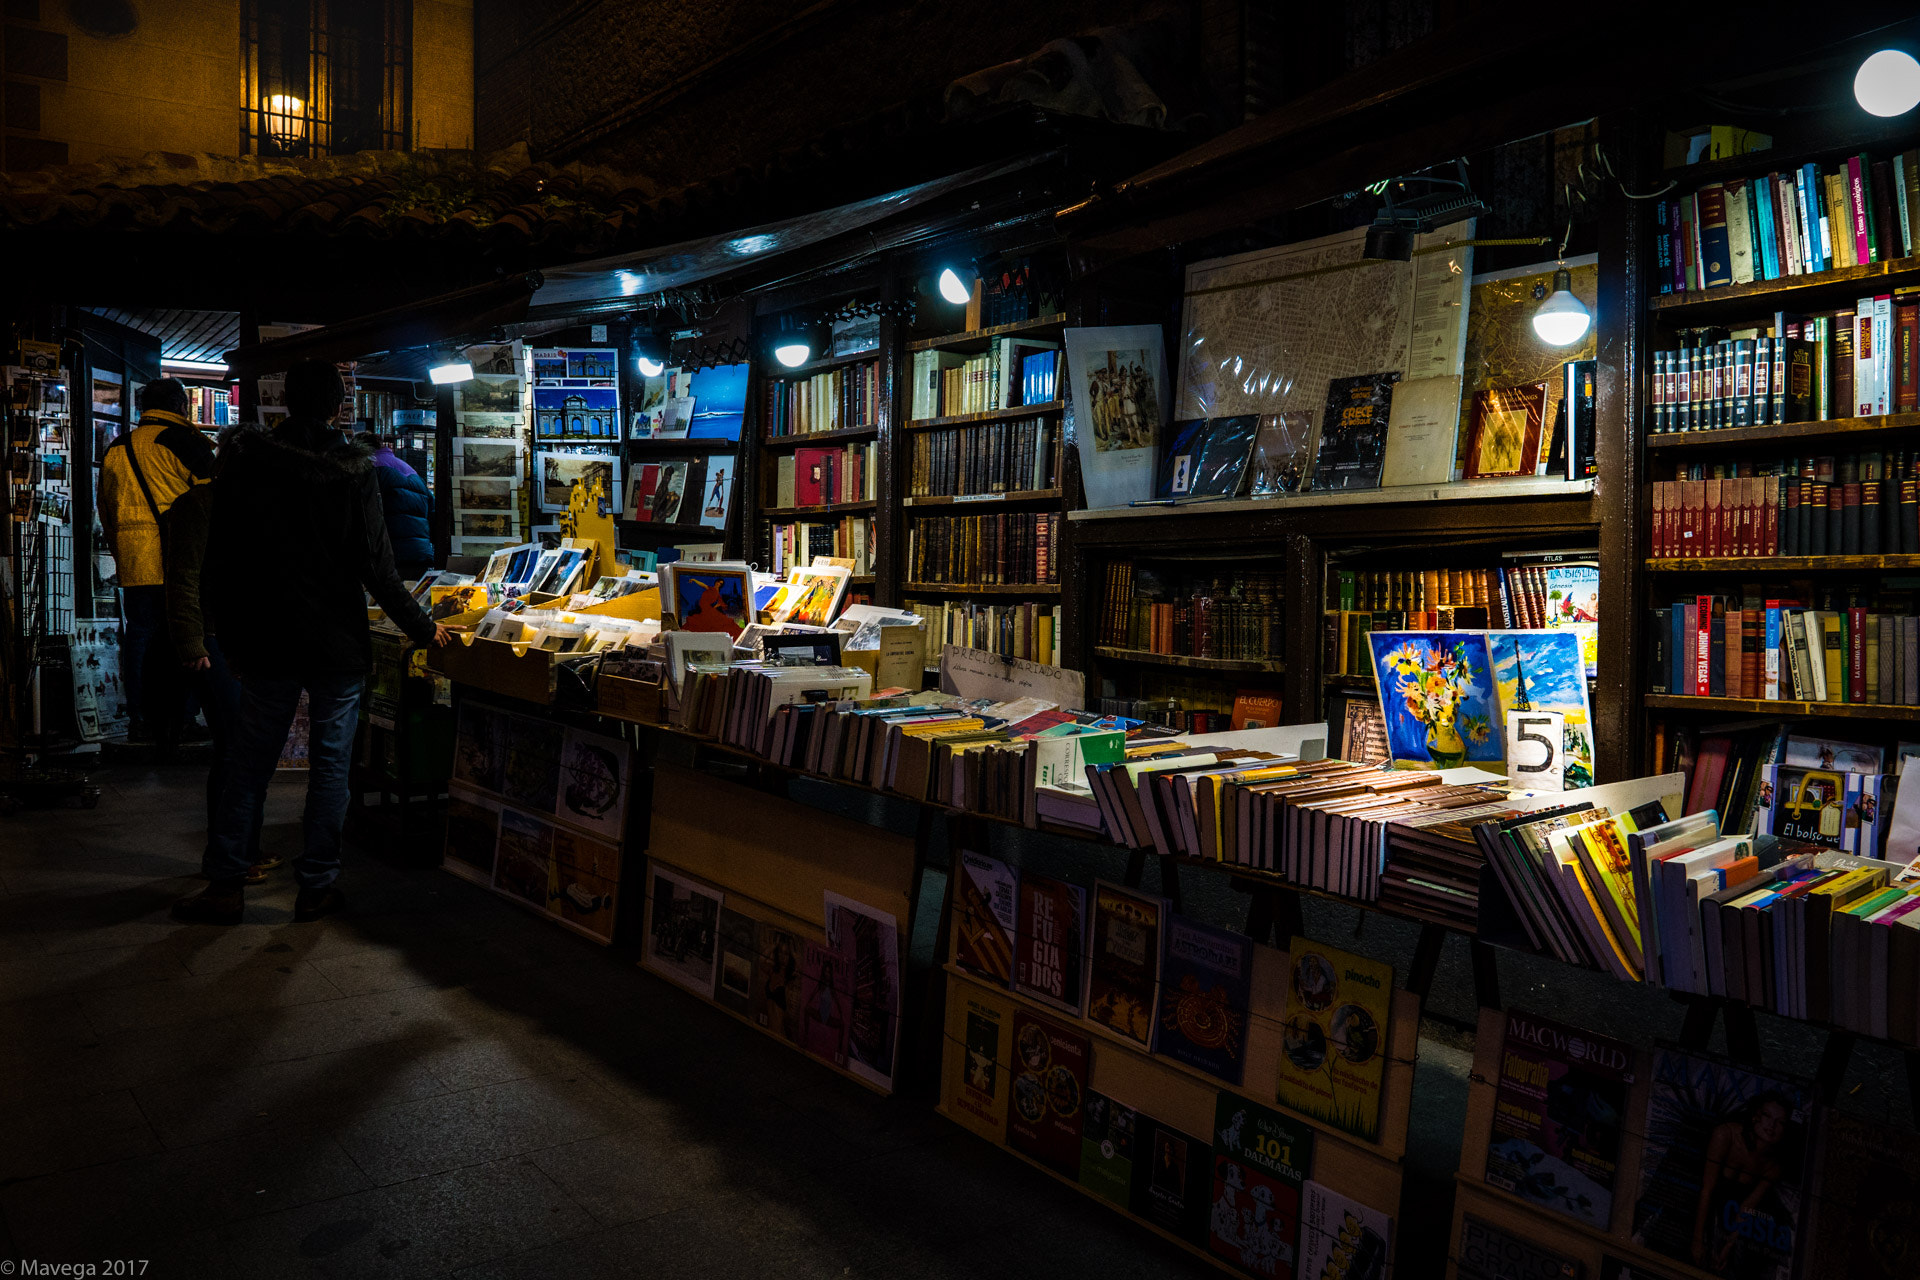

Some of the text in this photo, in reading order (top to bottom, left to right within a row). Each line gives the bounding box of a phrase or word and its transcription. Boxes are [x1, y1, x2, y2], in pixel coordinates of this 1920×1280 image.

[1342, 405, 1374, 419] CRECE
[951, 646, 996, 666] PRECIO
[1697, 598, 1708, 684] BECOMING JOHNNY VEGAS
[1248, 696, 1280, 708] CUERPO
[1517, 717, 1555, 773] 5
[1783, 823, 1793, 837] El
[1796, 824, 1823, 841] bolso
[1032, 891, 1055, 922] RE
[1032, 913, 1054, 943] FU
[1032, 939, 1060, 971] GIA
[1031, 961, 1062, 998] DOS
[1344, 967, 1381, 989] pinocho
[1508, 1016, 1628, 1071] MACWORLD
[1244, 1147, 1303, 1182] DALMATAS
[1255, 1133, 1292, 1168] 101
[1723, 1199, 1792, 1253] Casta
[1467, 1225, 1562, 1278] PHOTO
